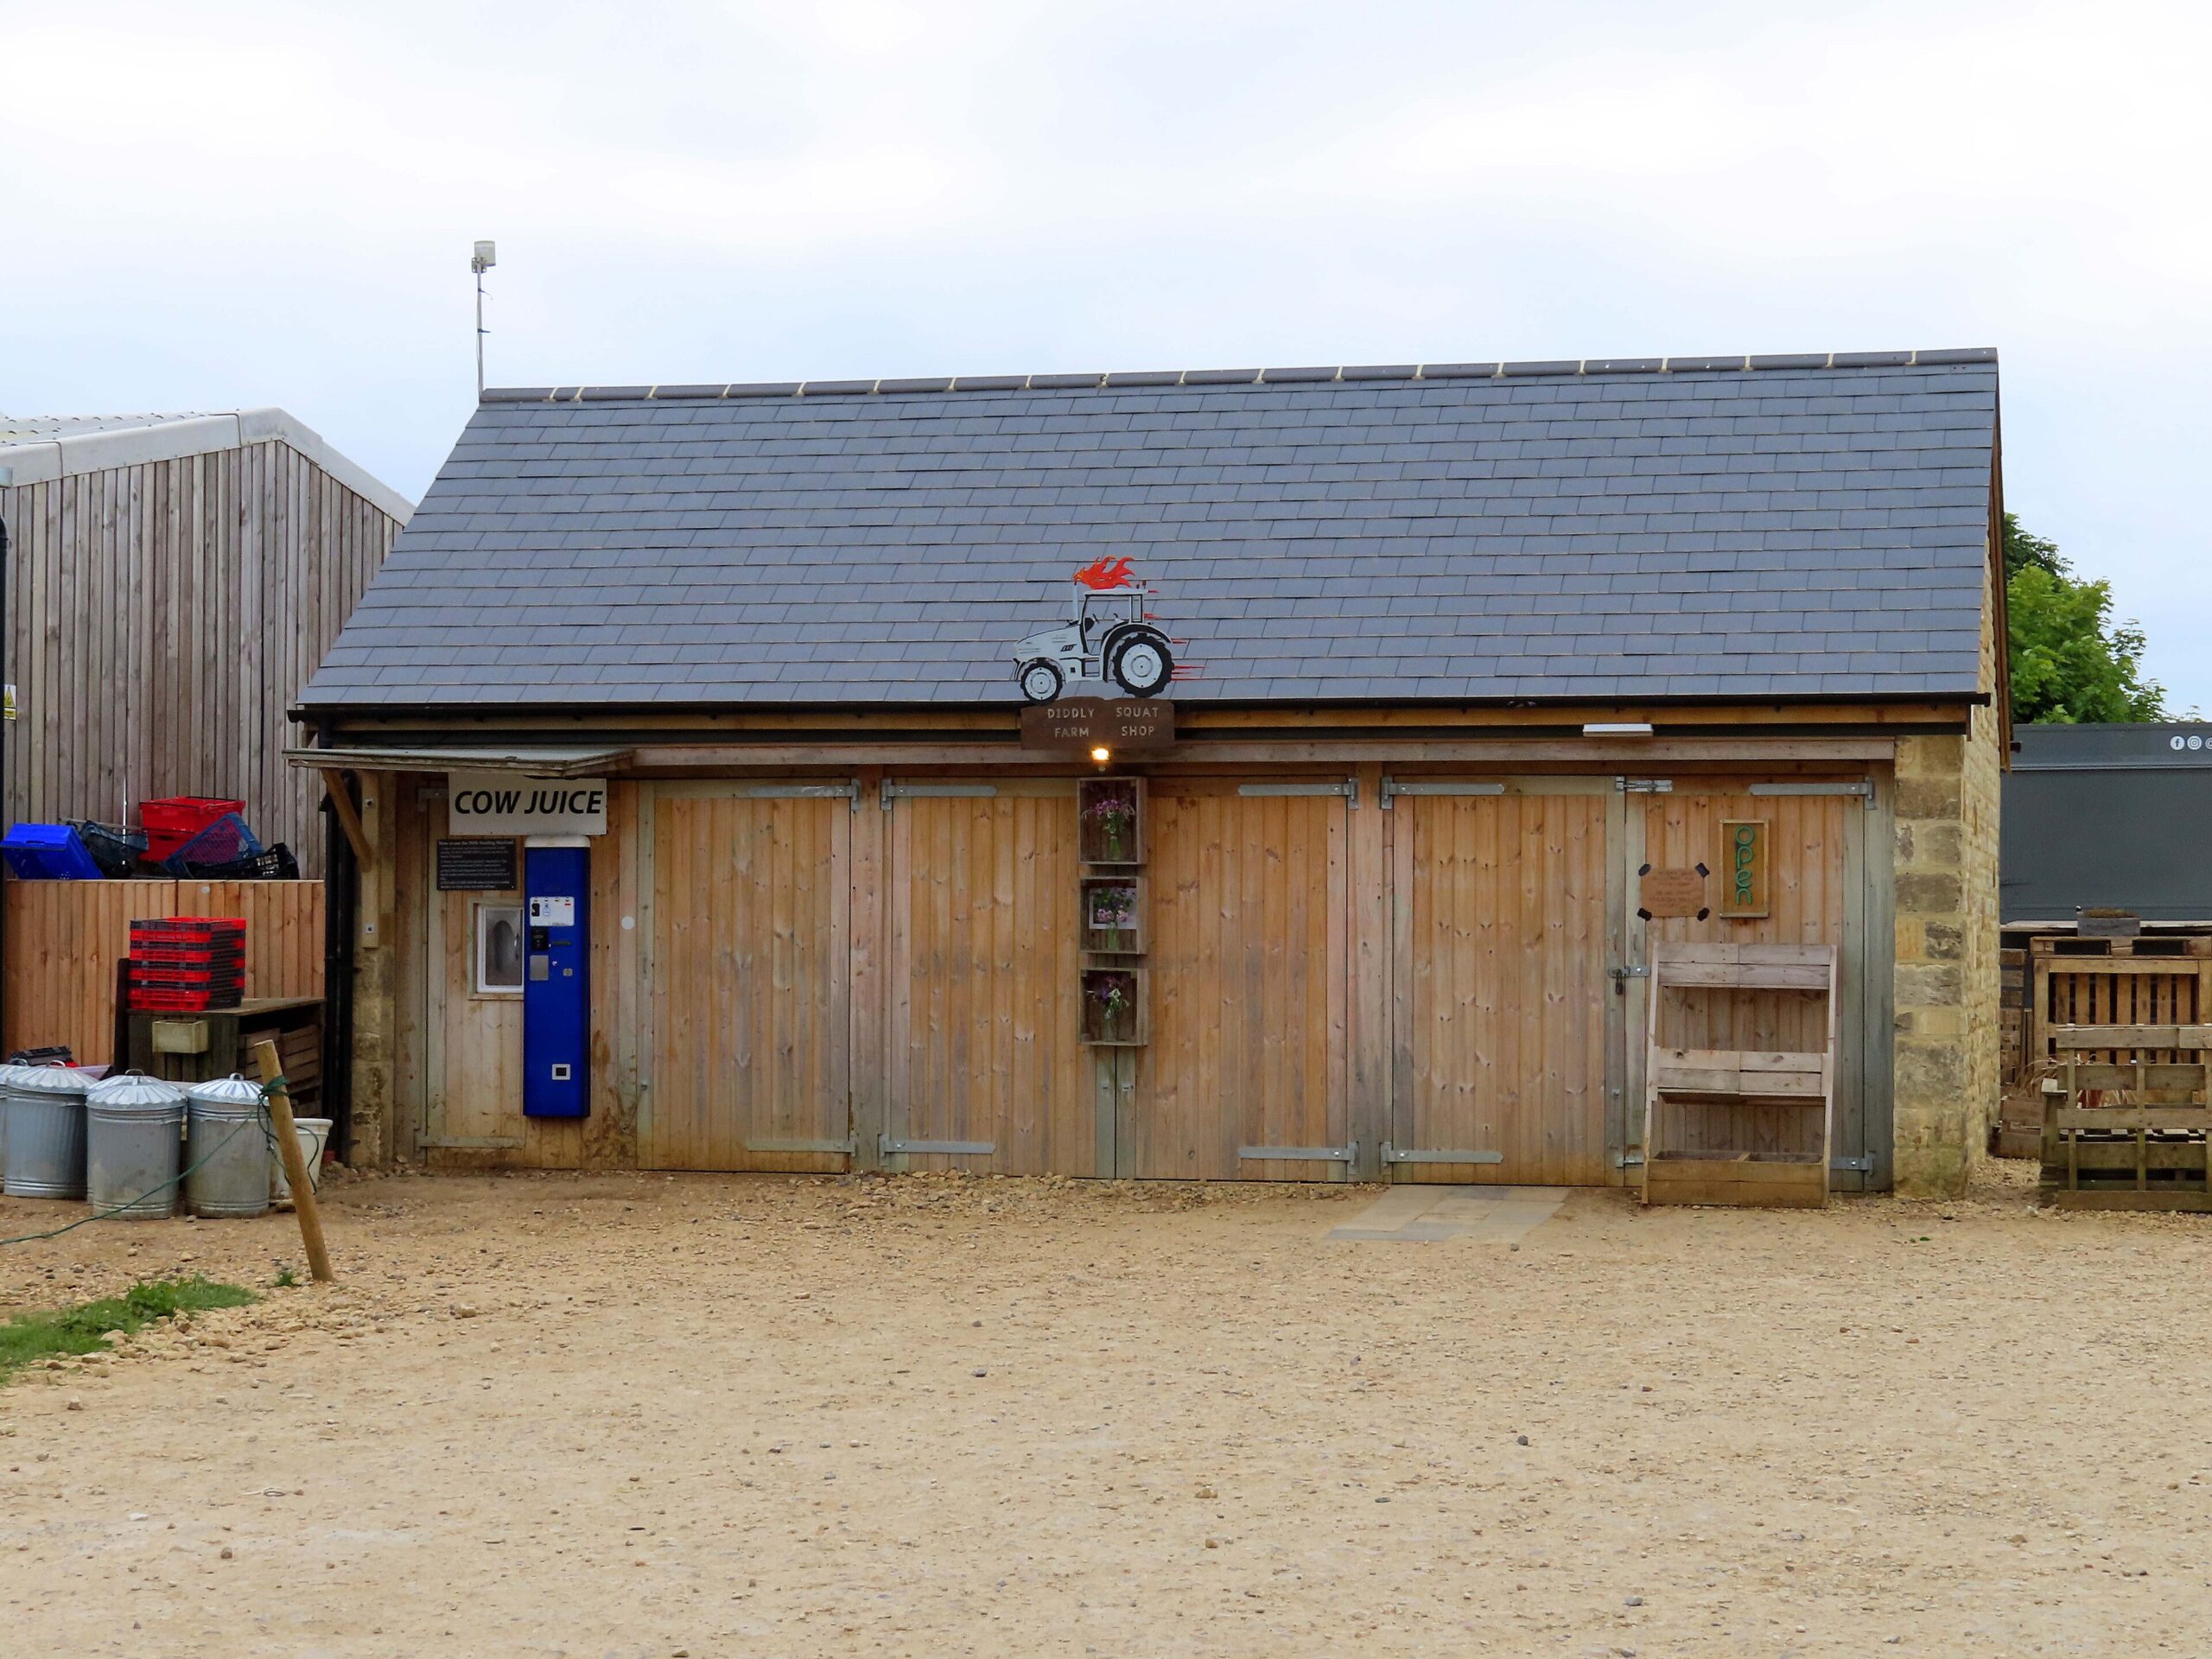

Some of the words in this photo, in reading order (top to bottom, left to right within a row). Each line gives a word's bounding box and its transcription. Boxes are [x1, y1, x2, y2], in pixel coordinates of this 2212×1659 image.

[1046, 707, 1096, 719] DIDDLY
[1116, 706, 1160, 718] SQUAT
[1054, 727, 1090, 738] FARM
[1121, 725, 1155, 737] SHOP
[454, 791, 520, 814] COW
[524, 791, 603, 814] JUICE
